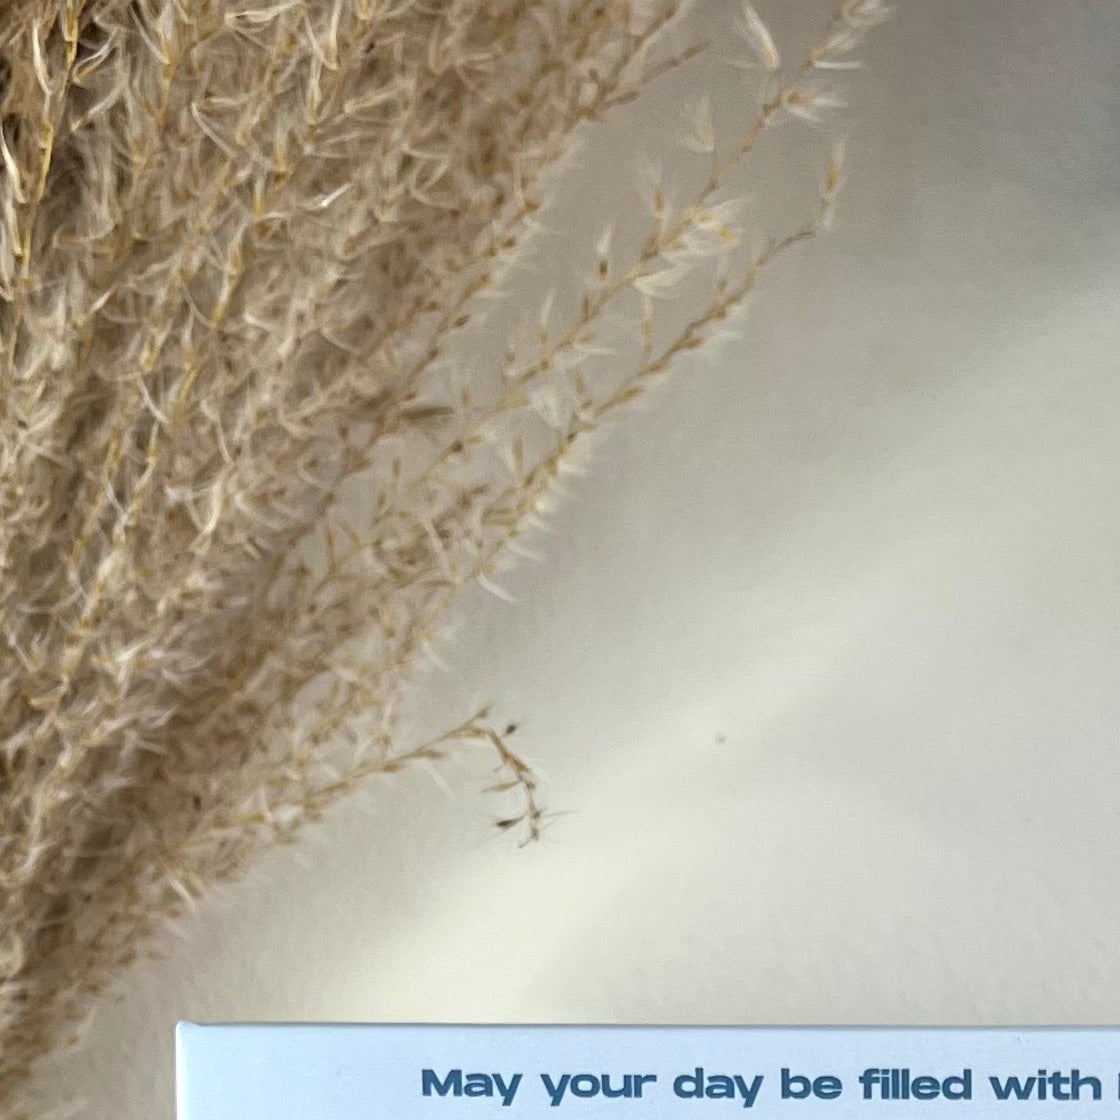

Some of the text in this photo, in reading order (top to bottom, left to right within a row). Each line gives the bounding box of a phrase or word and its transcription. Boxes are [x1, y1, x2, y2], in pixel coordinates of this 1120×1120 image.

[421, 1068, 524, 1107] May
[539, 1073, 658, 1107] your
[672, 1066, 765, 1109] day
[780, 1067, 843, 1100] be
[858, 1067, 973, 1101] filled
[988, 1068, 1102, 1101] with
